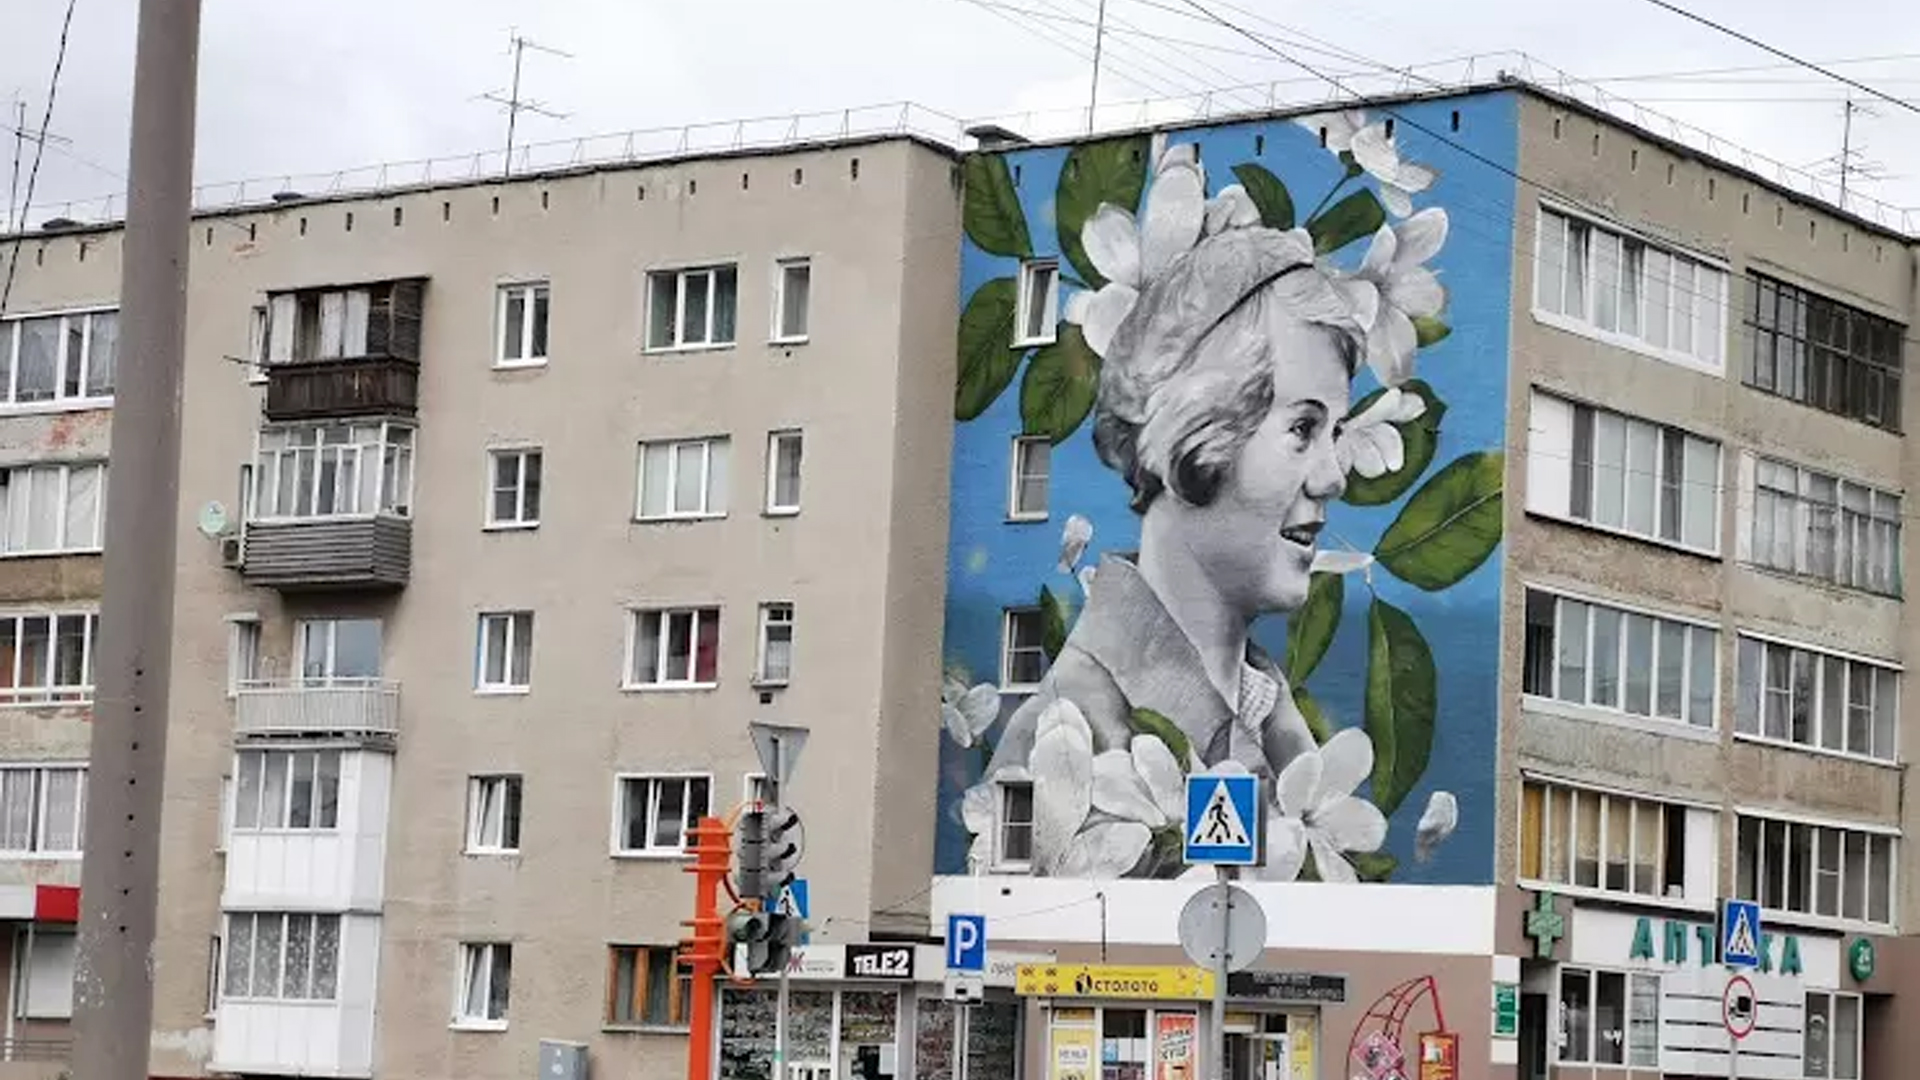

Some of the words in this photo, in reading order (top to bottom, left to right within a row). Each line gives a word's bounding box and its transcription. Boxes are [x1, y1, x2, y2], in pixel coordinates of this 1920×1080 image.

[954, 920, 977, 965] P
[1629, 917, 1802, 976] АПТКА
[853, 949, 909, 976] TELE2
[1094, 980, 1158, 993] СТОЛОТО
